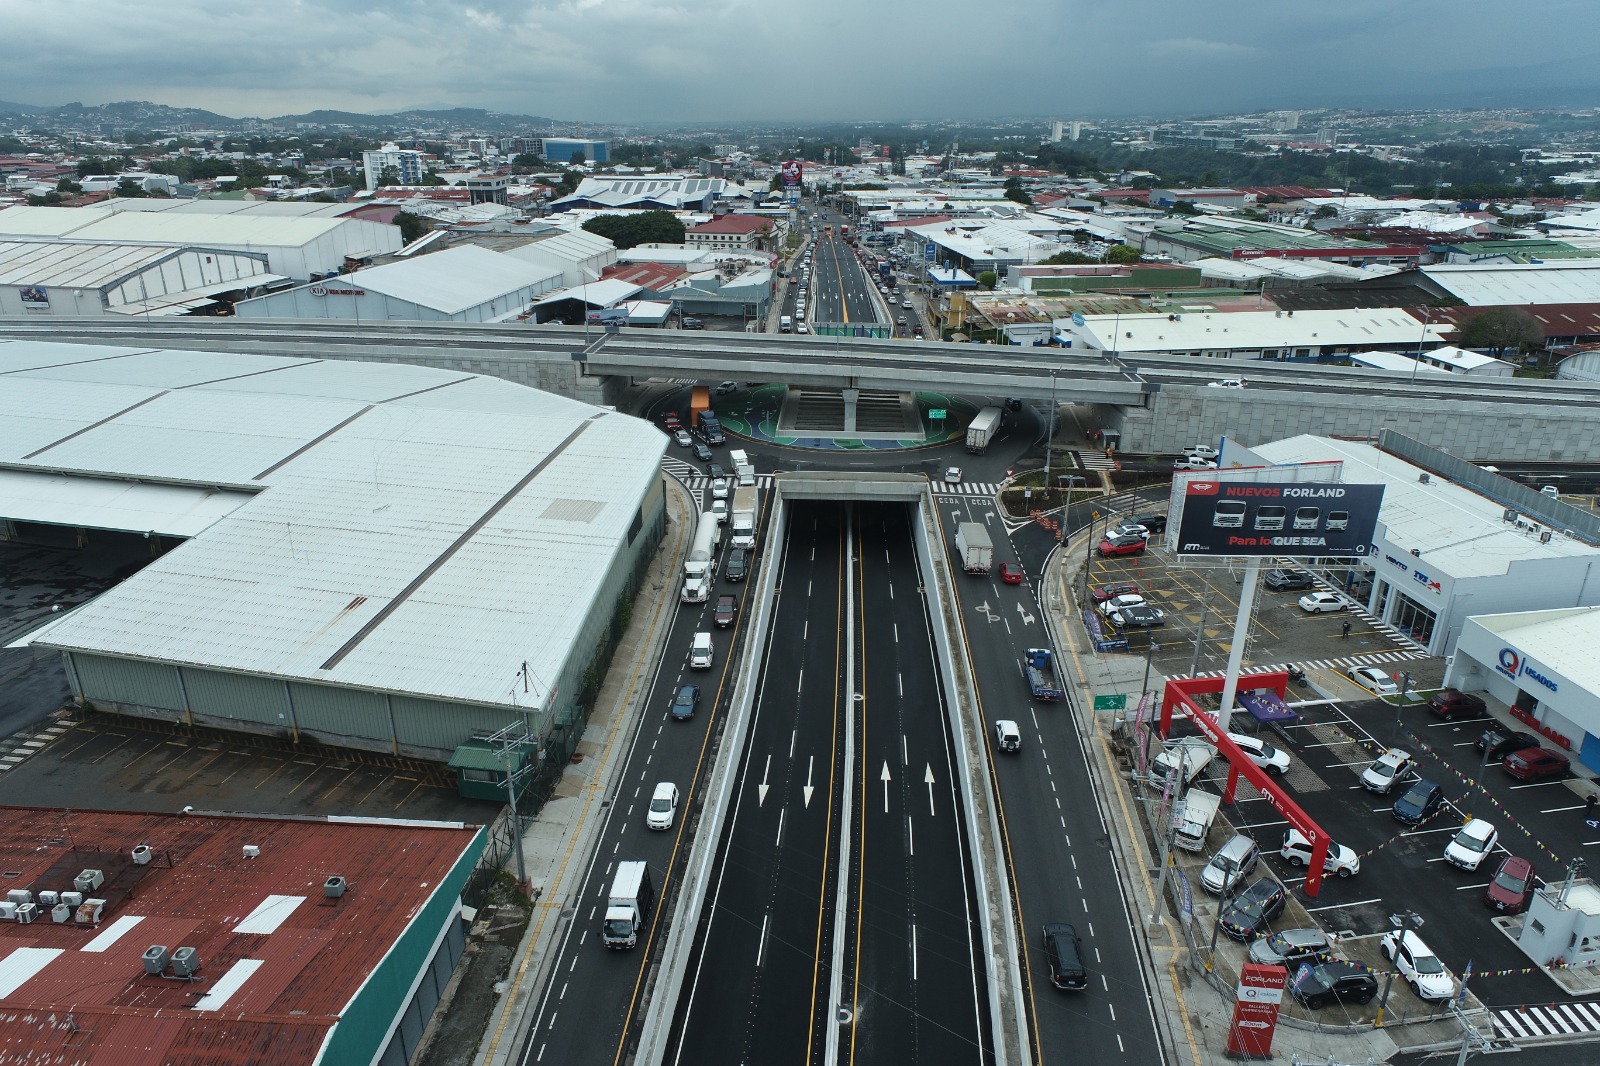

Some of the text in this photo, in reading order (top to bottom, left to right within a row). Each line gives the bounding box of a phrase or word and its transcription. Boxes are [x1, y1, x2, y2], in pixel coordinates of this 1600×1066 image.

[1227, 487, 1346, 498] NUEVOS FORLAND
[1229, 536, 1326, 546] Para lo QUE SEA
[1386, 555, 1408, 570] VENTO
[1414, 570, 1429, 583] TVS
[1499, 648, 1519, 674] Q
[1525, 666, 1558, 692] USADOS
